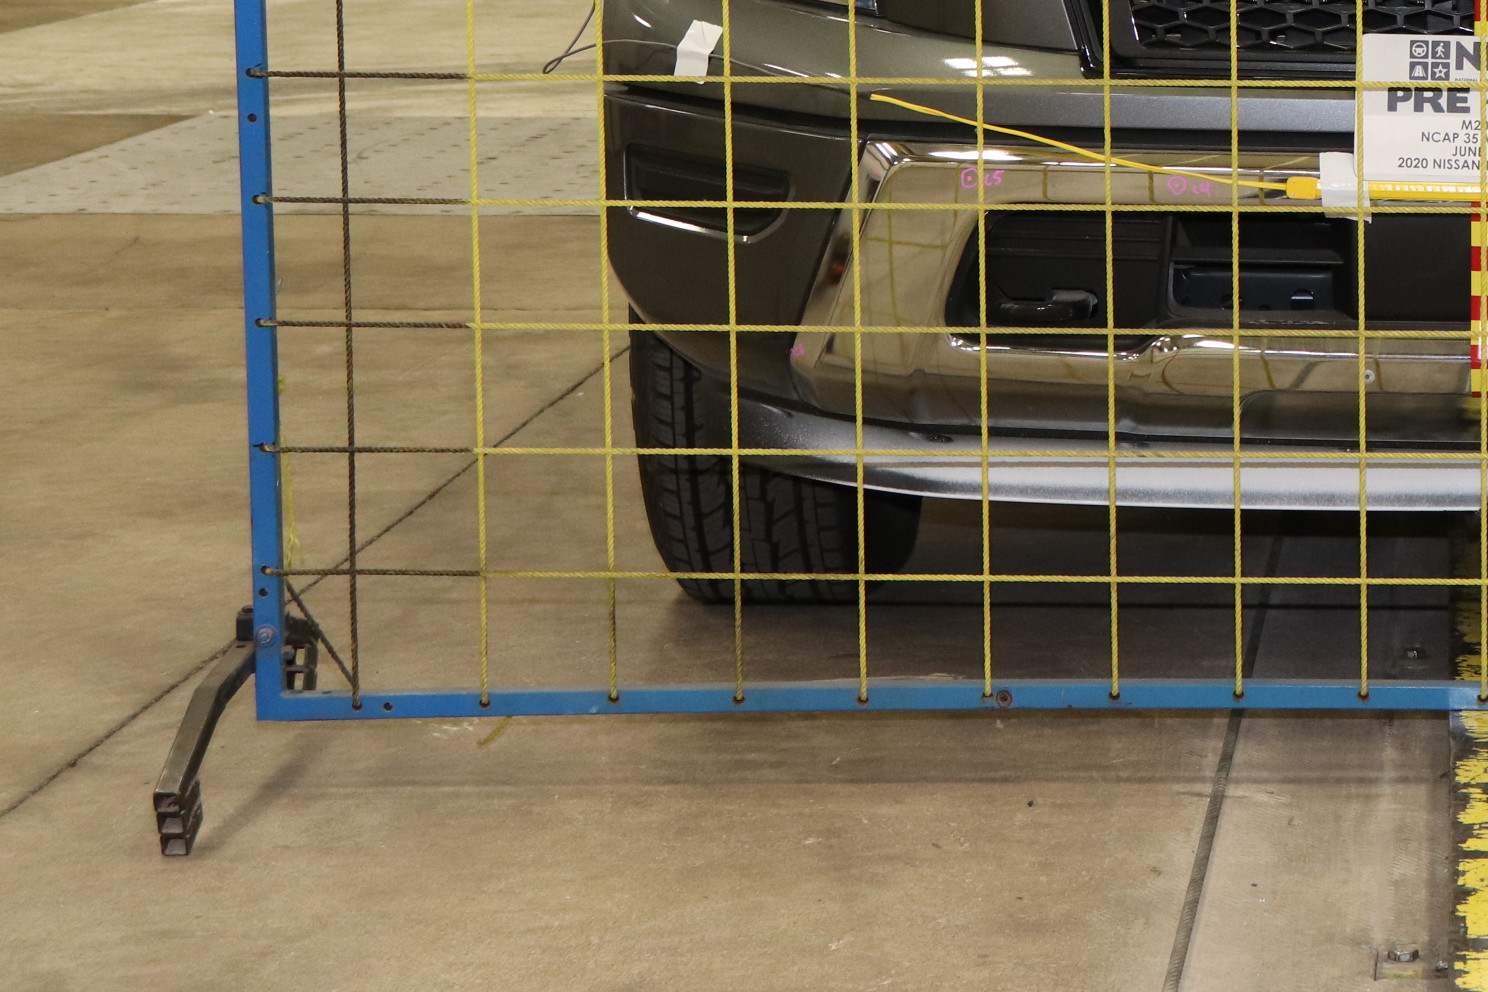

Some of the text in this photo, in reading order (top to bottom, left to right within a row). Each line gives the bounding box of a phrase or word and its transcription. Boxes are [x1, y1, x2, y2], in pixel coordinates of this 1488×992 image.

[1387, 87, 1471, 114] PRE
[1421, 132, 1459, 143] NCAP
[1463, 133, 1479, 144] 35
[1397, 157, 1429, 169] 2020
[1433, 159, 1481, 170] NISSAN
